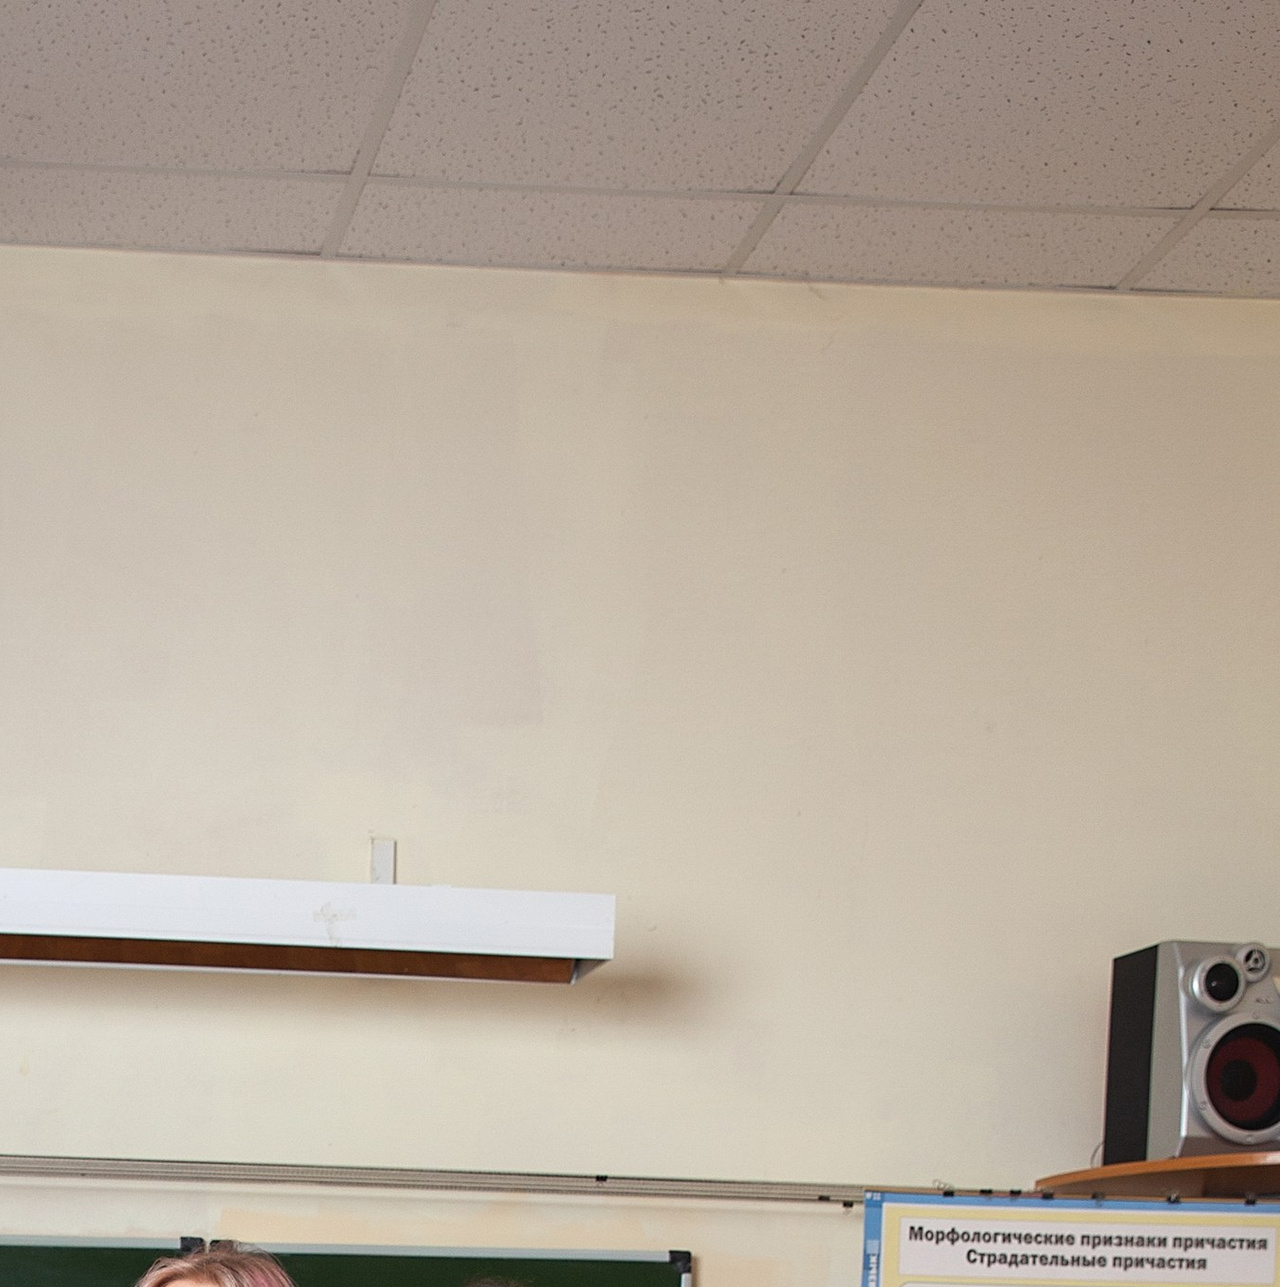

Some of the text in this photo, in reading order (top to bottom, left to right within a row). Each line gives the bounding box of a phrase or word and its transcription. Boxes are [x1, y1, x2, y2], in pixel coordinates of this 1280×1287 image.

[909, 1226, 1268, 1252] Морфологические признаки причастия
[966, 1249, 1207, 1271] Страдательные причастия
